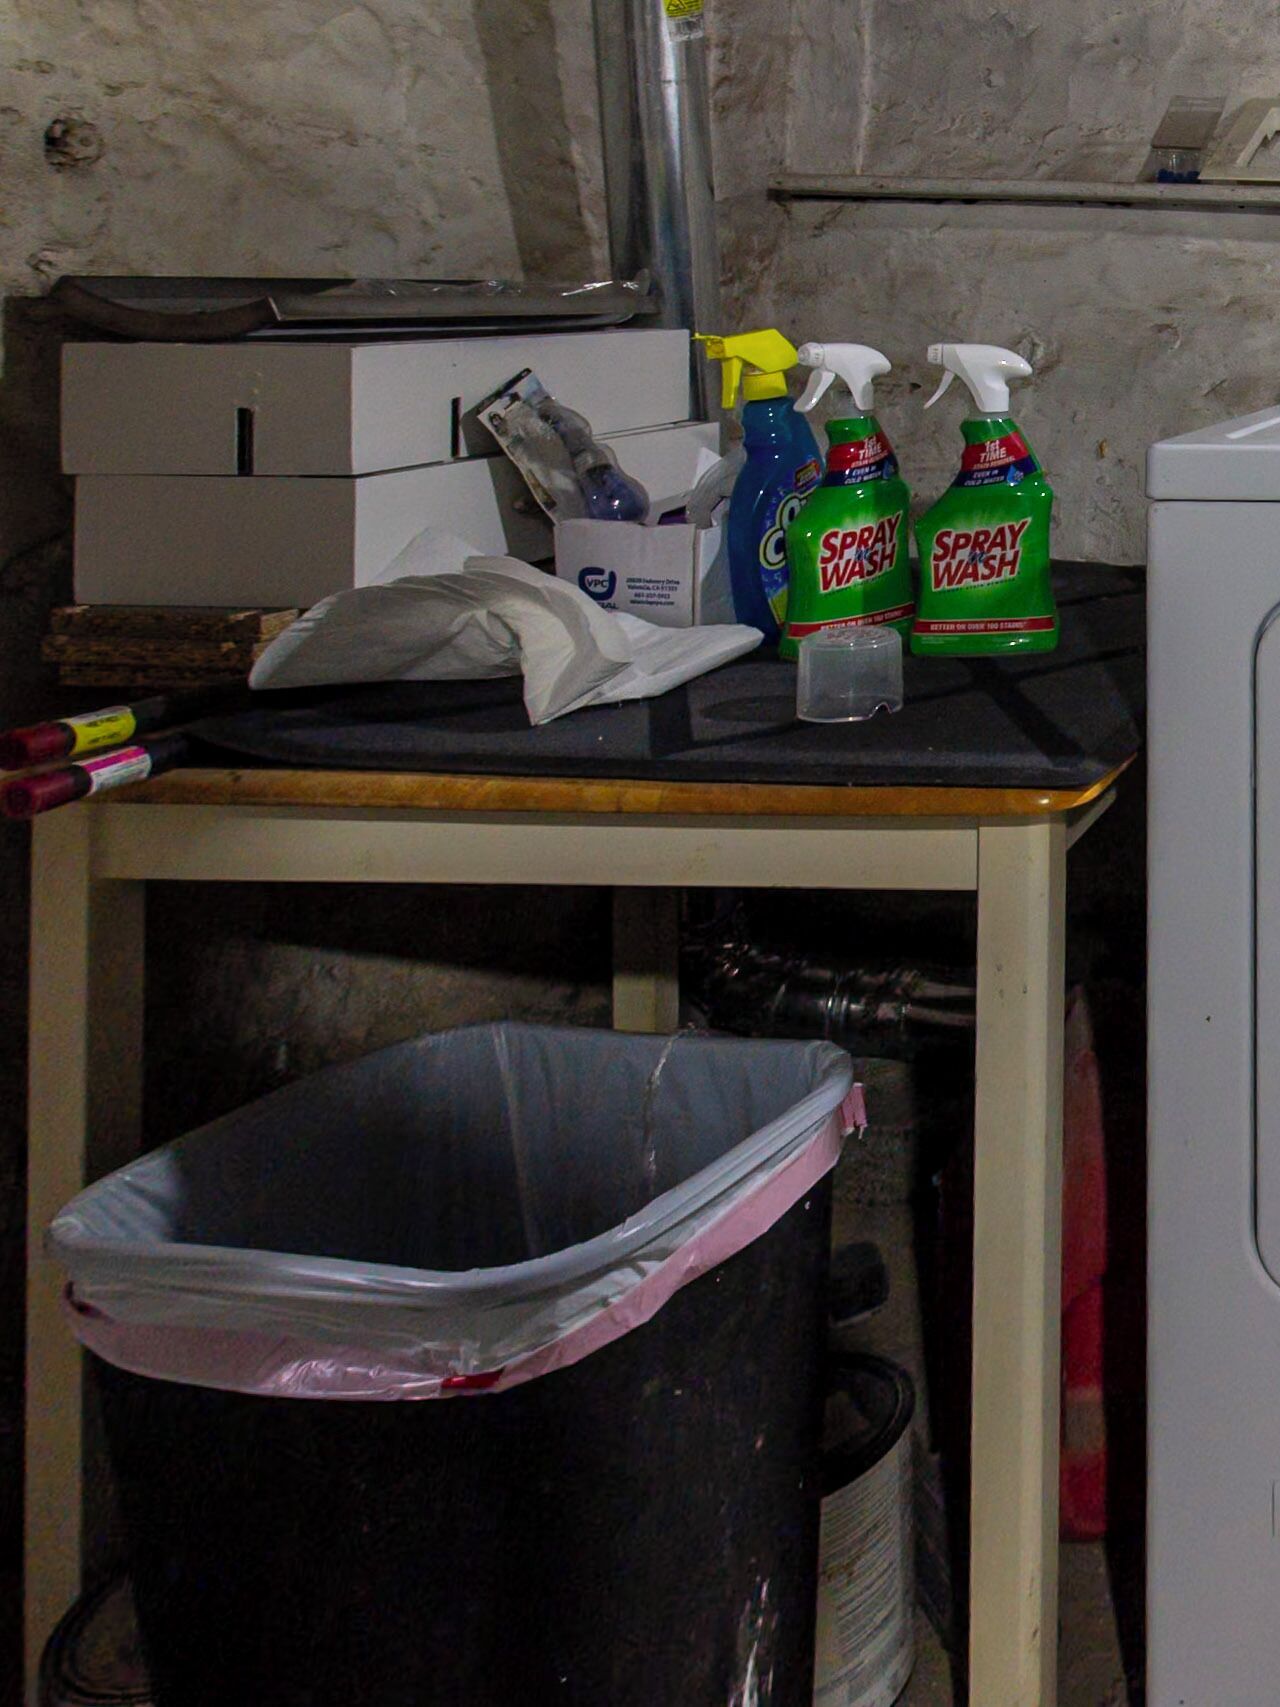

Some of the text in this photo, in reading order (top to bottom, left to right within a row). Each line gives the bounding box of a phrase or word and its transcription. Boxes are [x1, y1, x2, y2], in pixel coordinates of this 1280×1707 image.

[979, 447, 1007, 463] TIME
[820, 513, 902, 565] SPRAY
[933, 519, 1029, 563] SPRAY
[586, 578, 609, 588] VPC
[820, 543, 897, 592] WASH
[932, 549, 1019, 591] WASH
